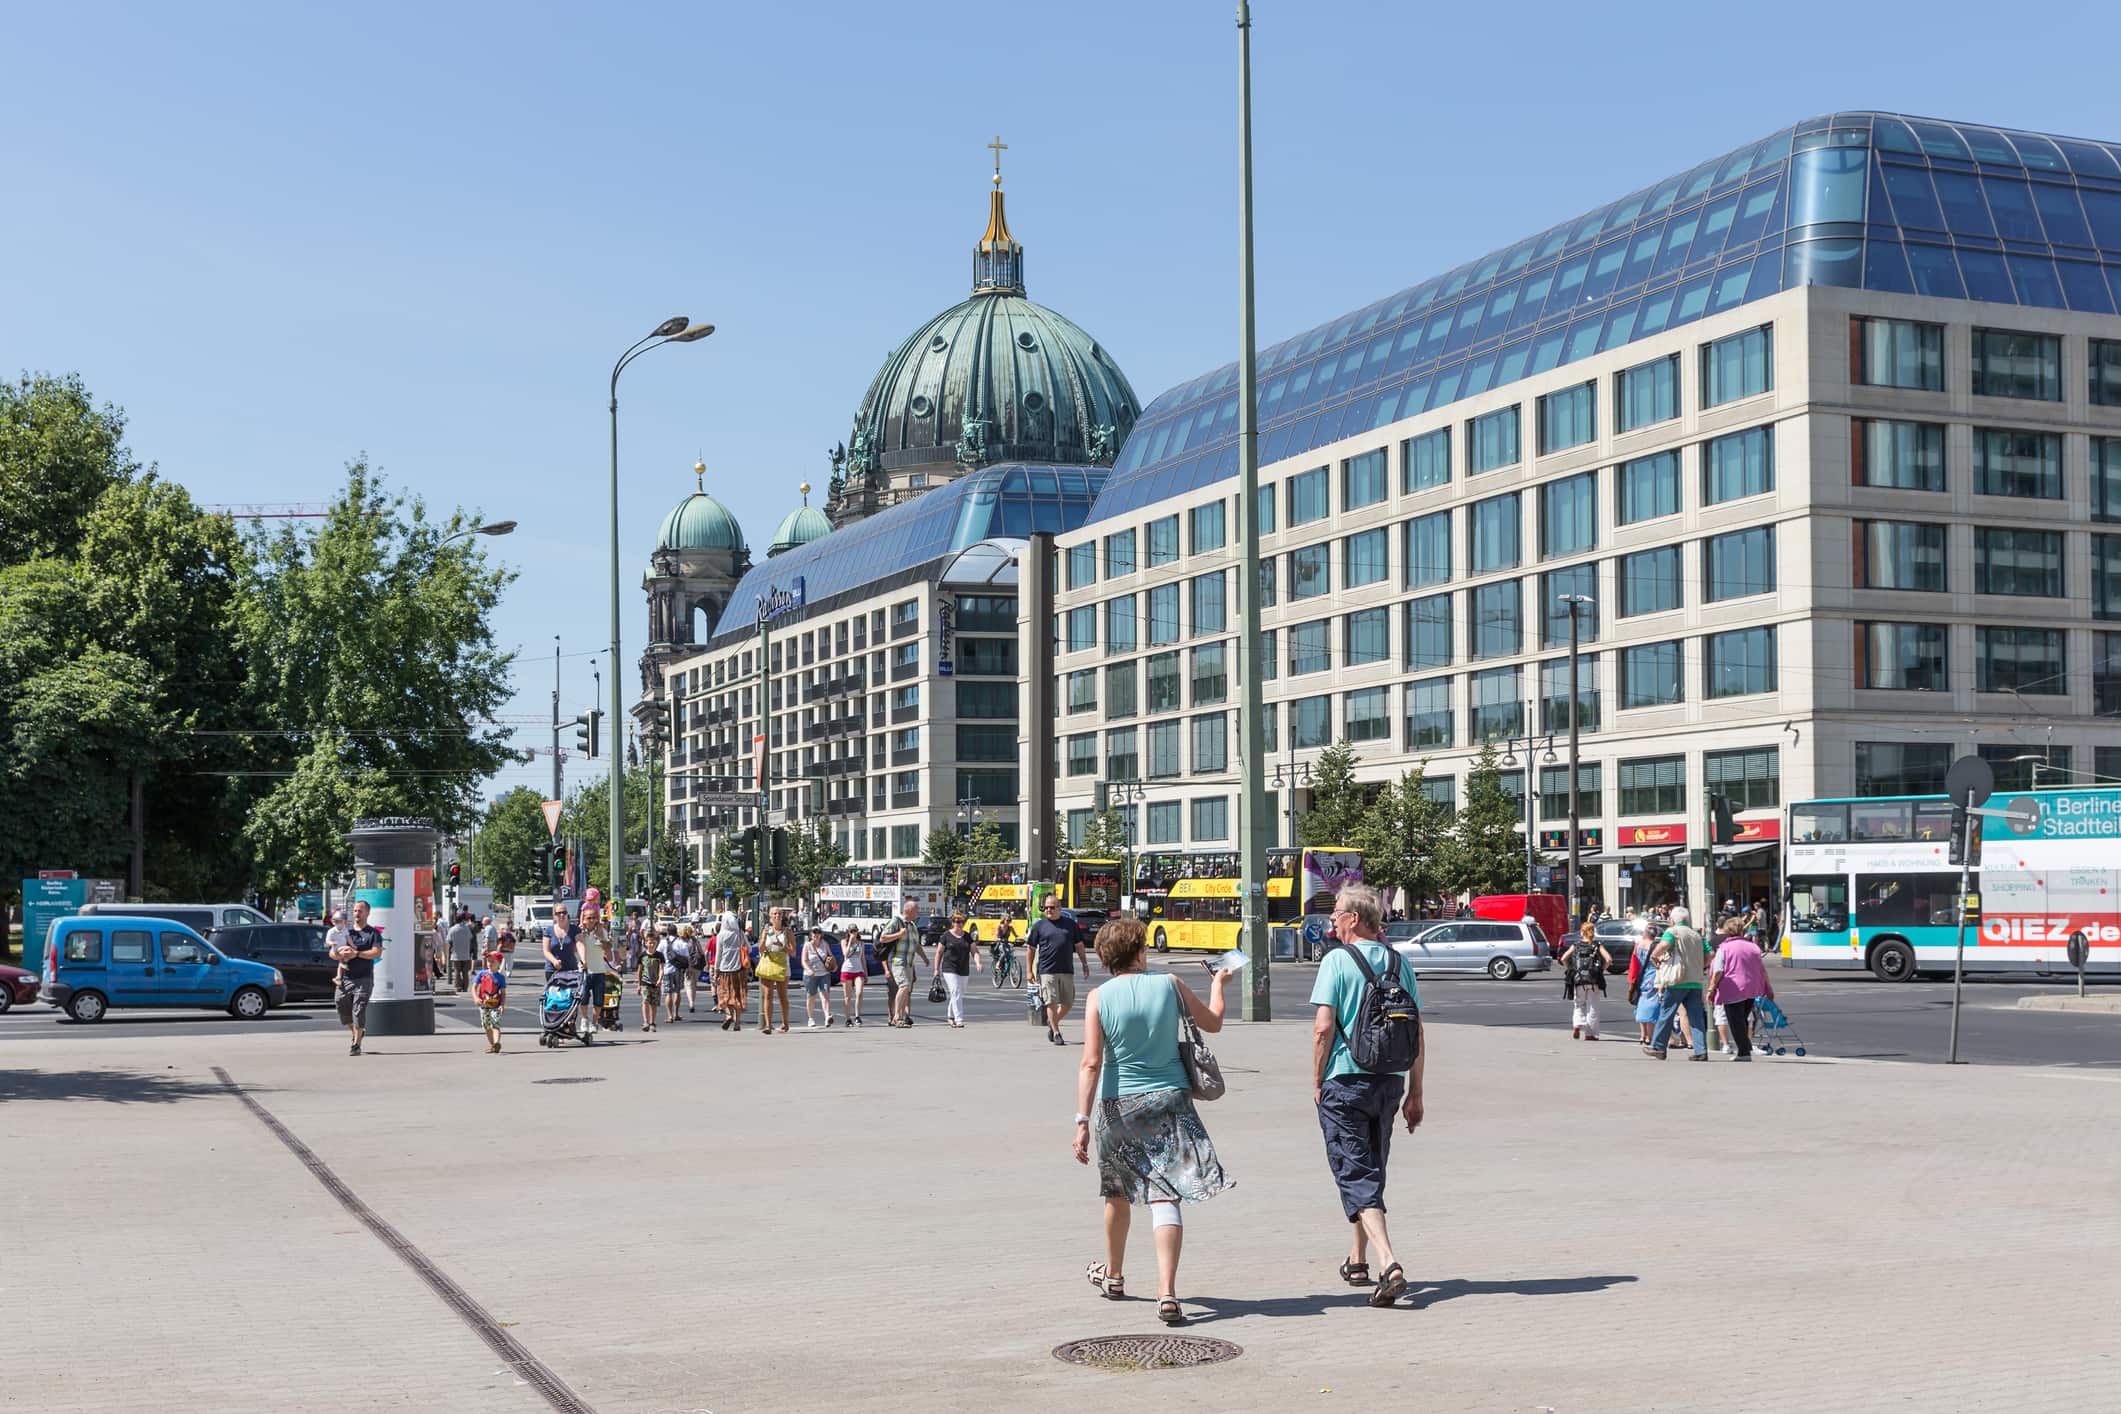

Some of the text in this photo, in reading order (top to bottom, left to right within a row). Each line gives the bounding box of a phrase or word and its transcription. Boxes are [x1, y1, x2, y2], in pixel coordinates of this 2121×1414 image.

[989, 886, 999, 897] City
[1205, 884, 1216, 896] City
[1217, 884, 1232, 893] Circle
